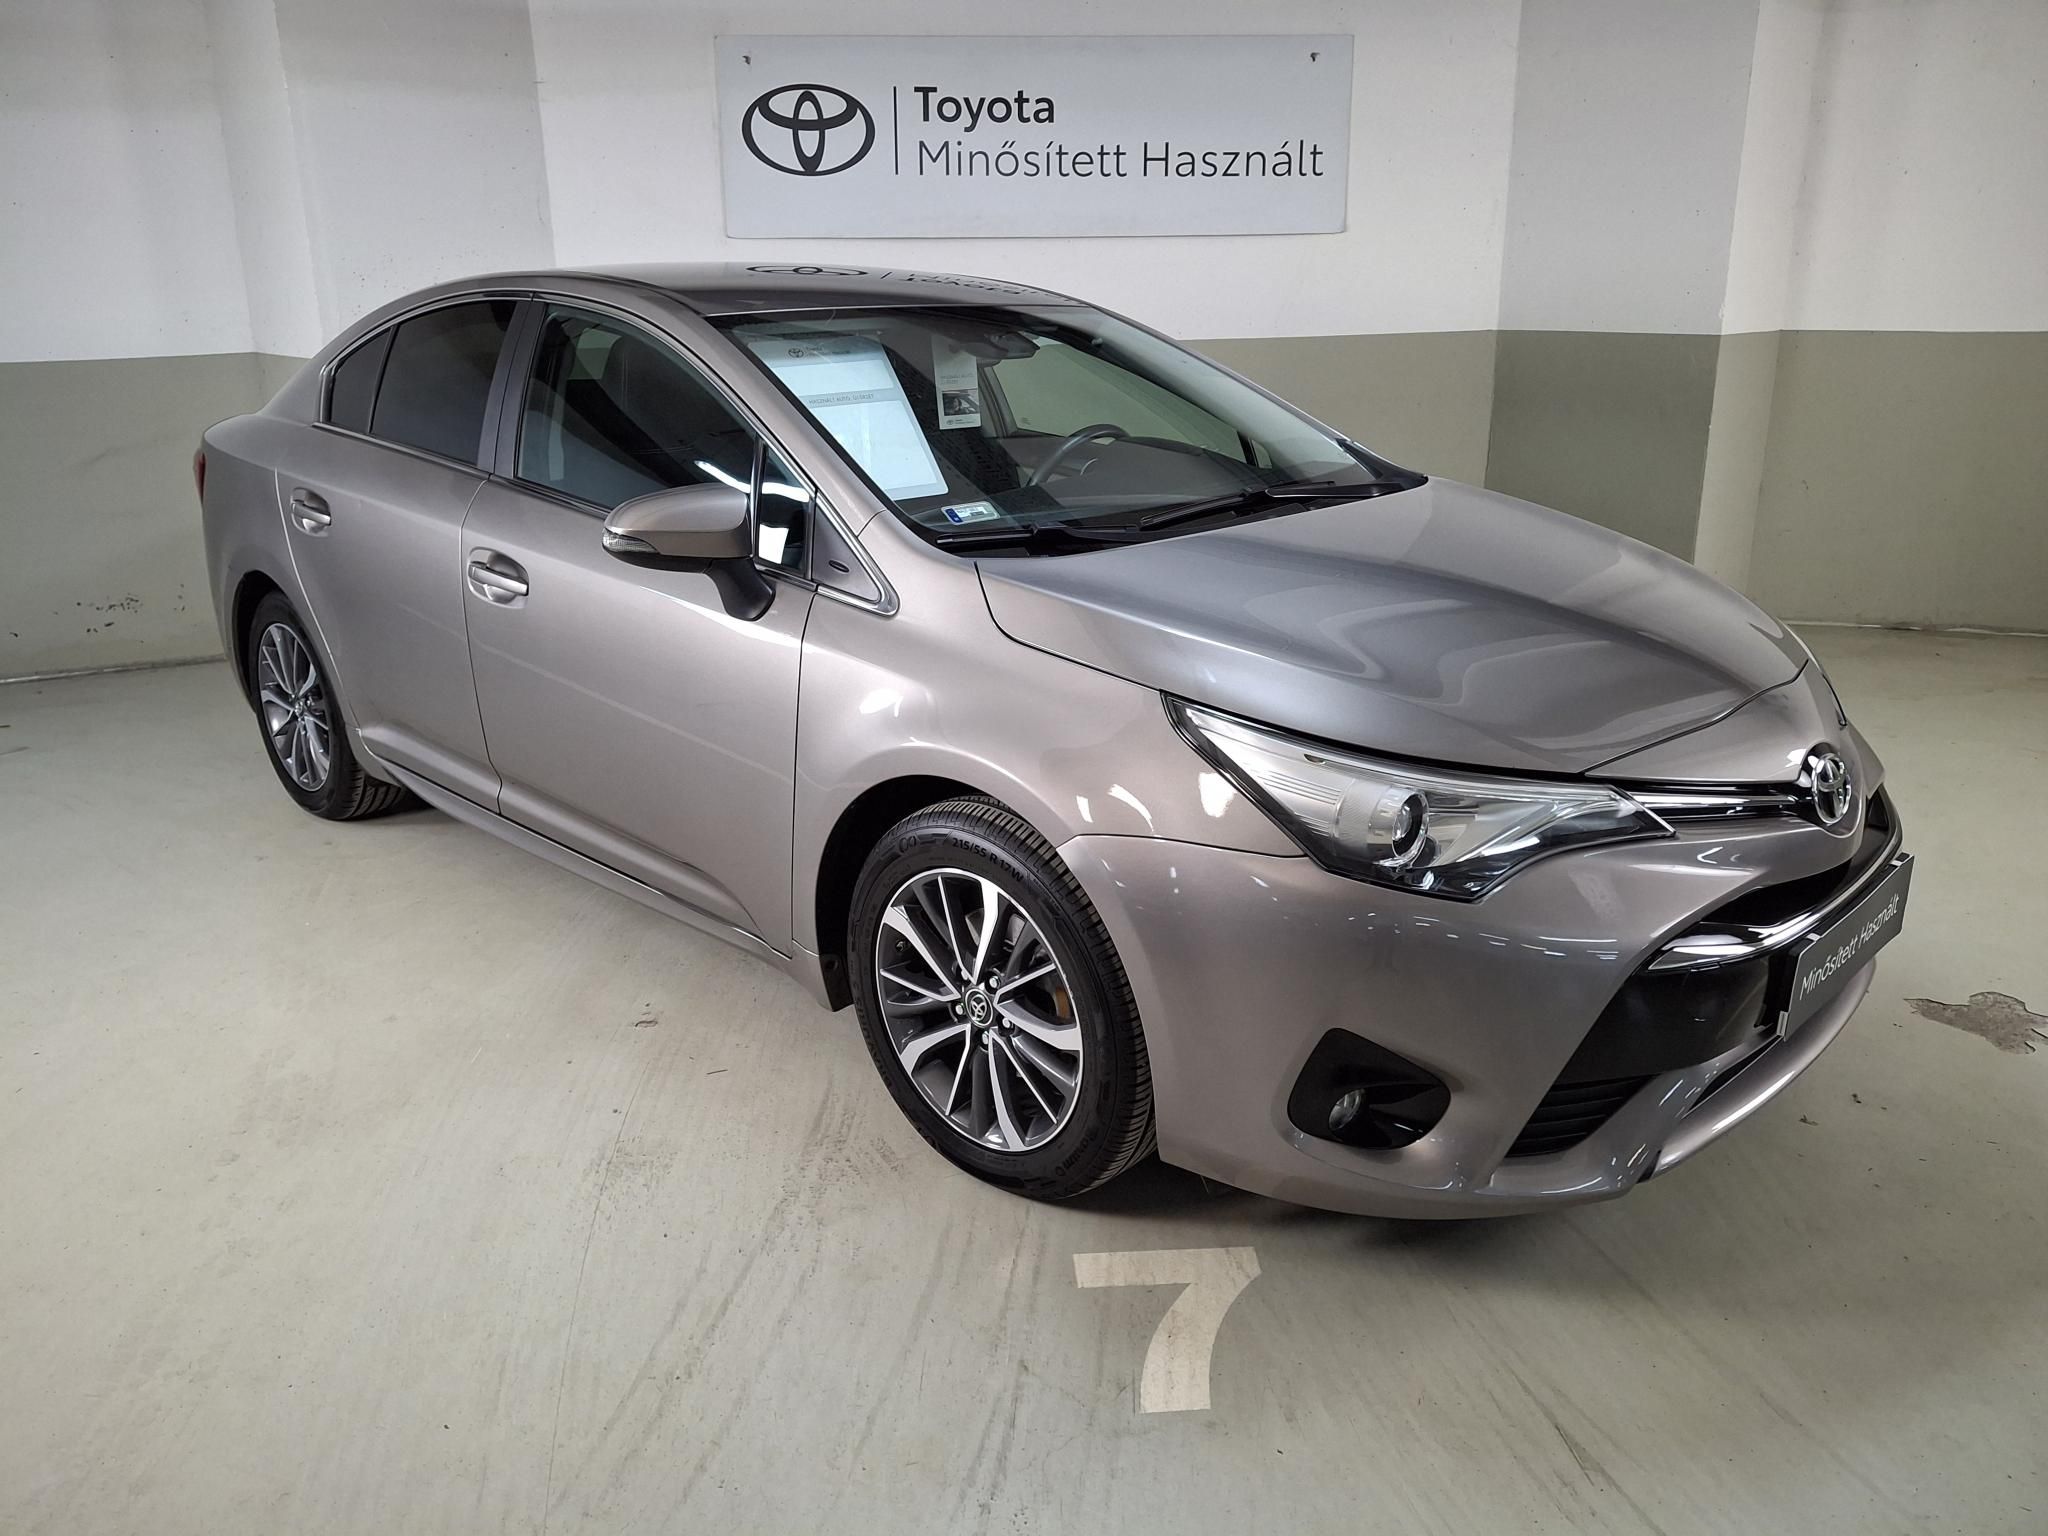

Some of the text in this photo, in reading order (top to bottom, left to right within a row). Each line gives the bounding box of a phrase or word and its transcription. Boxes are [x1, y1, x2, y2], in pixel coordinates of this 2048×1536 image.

[914, 86, 1055, 132] Toyota
[918, 139, 1325, 177] Minősített Használt
[952, 837, 987, 858] 215/55
[1858, 892, 1900, 949] Használt
[1073, 1246, 1262, 1413] 7
